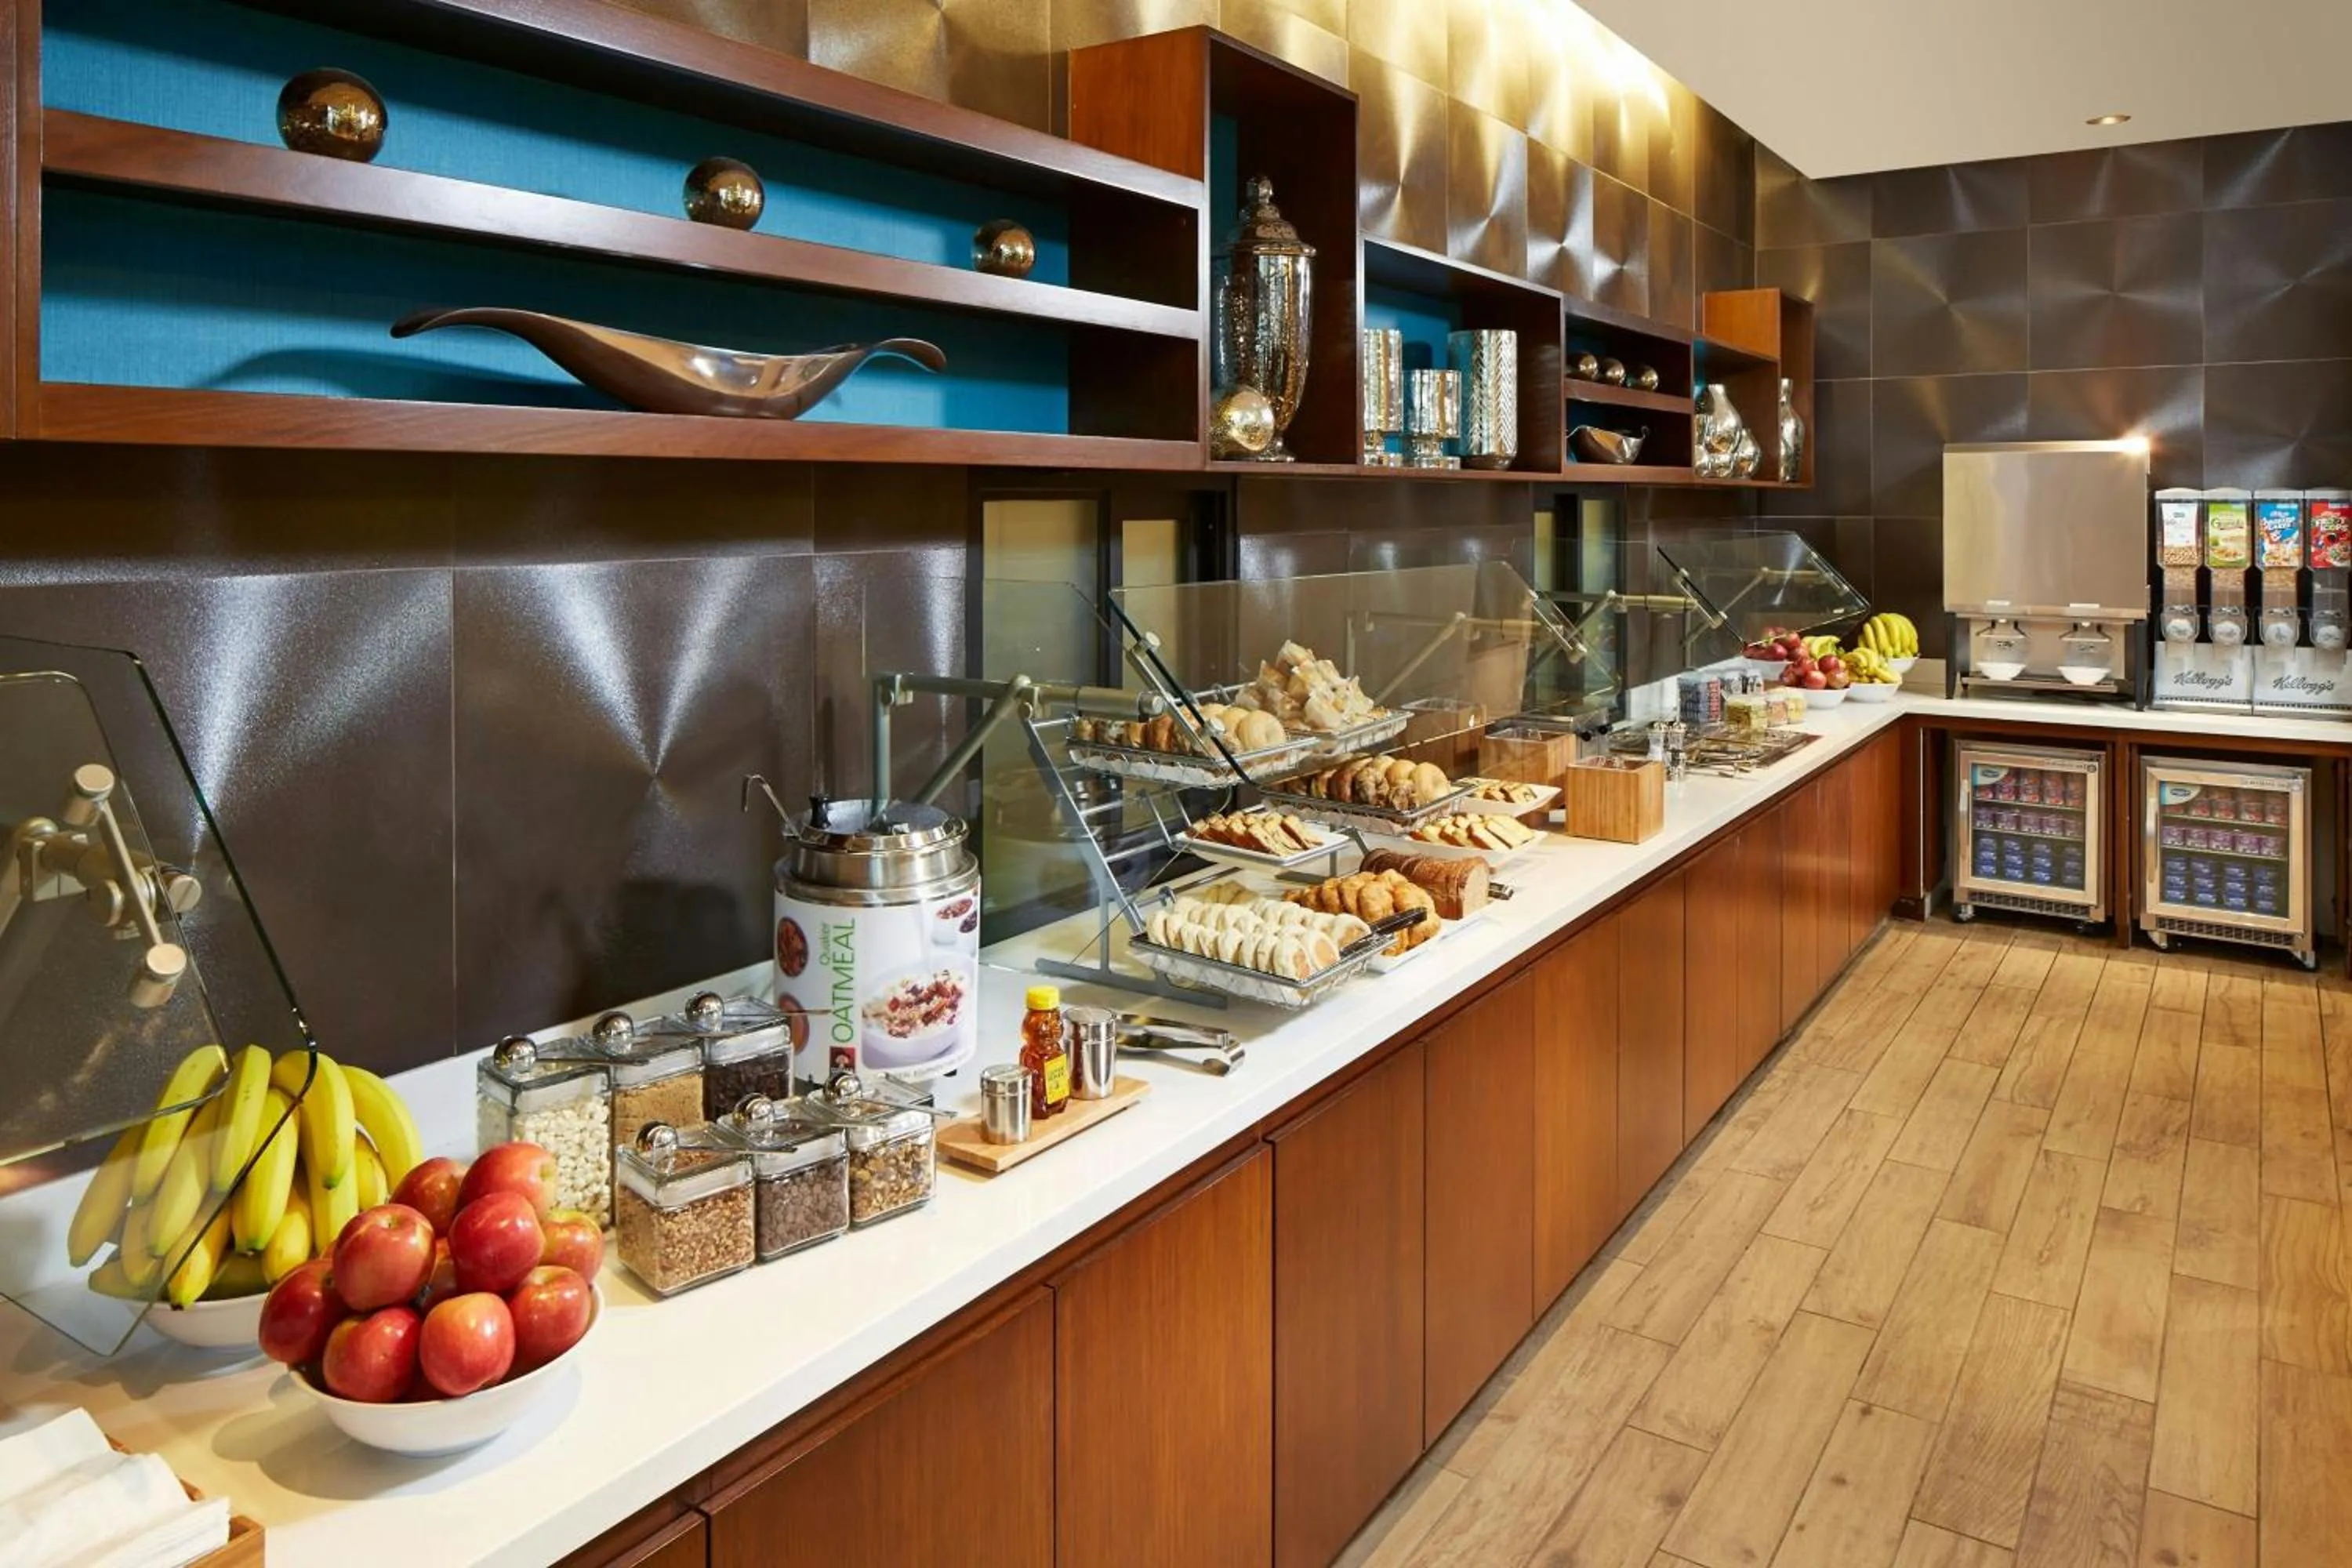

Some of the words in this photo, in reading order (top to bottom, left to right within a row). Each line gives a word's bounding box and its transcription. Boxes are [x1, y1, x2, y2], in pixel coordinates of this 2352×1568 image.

[2173, 670, 2234, 690] Kellogg's
[2272, 674, 2336, 695] Kellogg's
[831, 916, 855, 1043] OATMEAL
